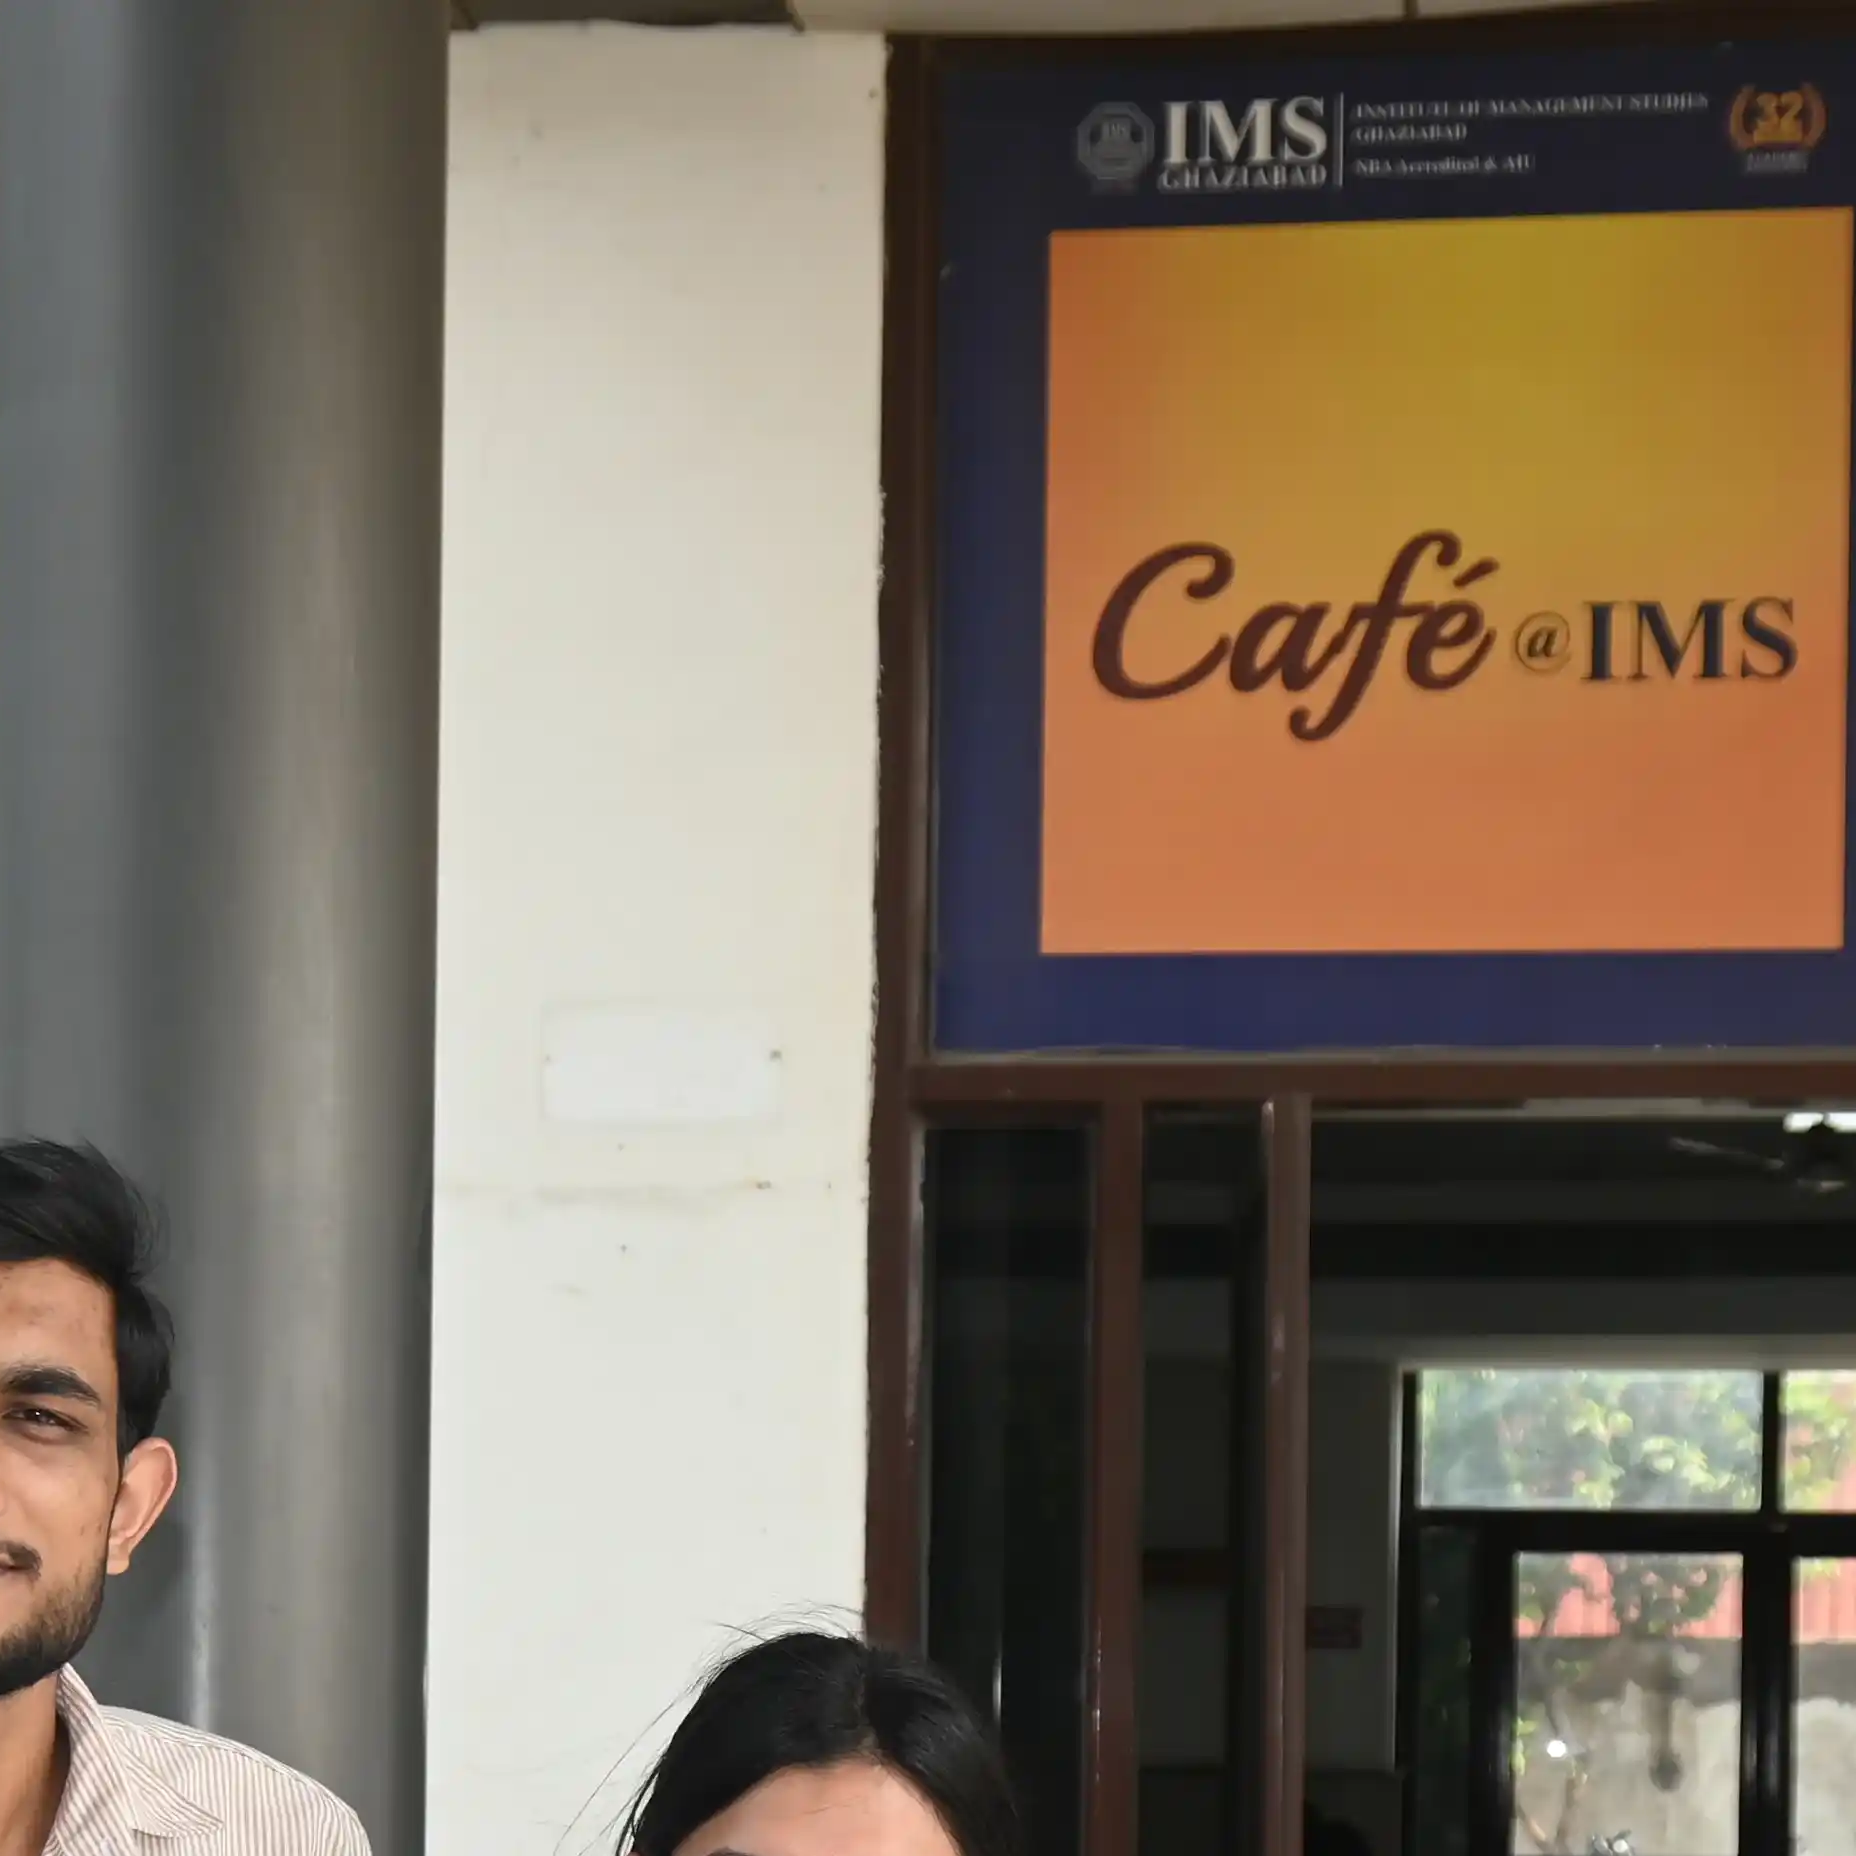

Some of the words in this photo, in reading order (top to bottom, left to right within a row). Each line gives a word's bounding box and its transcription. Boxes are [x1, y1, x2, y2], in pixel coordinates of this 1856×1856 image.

[1164, 95, 1328, 163] IMS
[1355, 122, 1467, 142] GHAZIABAD
[1754, 92, 1805, 142] 32
[1156, 163, 1327, 190] GHAZIABAD
[1092, 529, 1500, 741] Café
[1513, 610, 1572, 672] @
[1580, 596, 1799, 681] IMS
